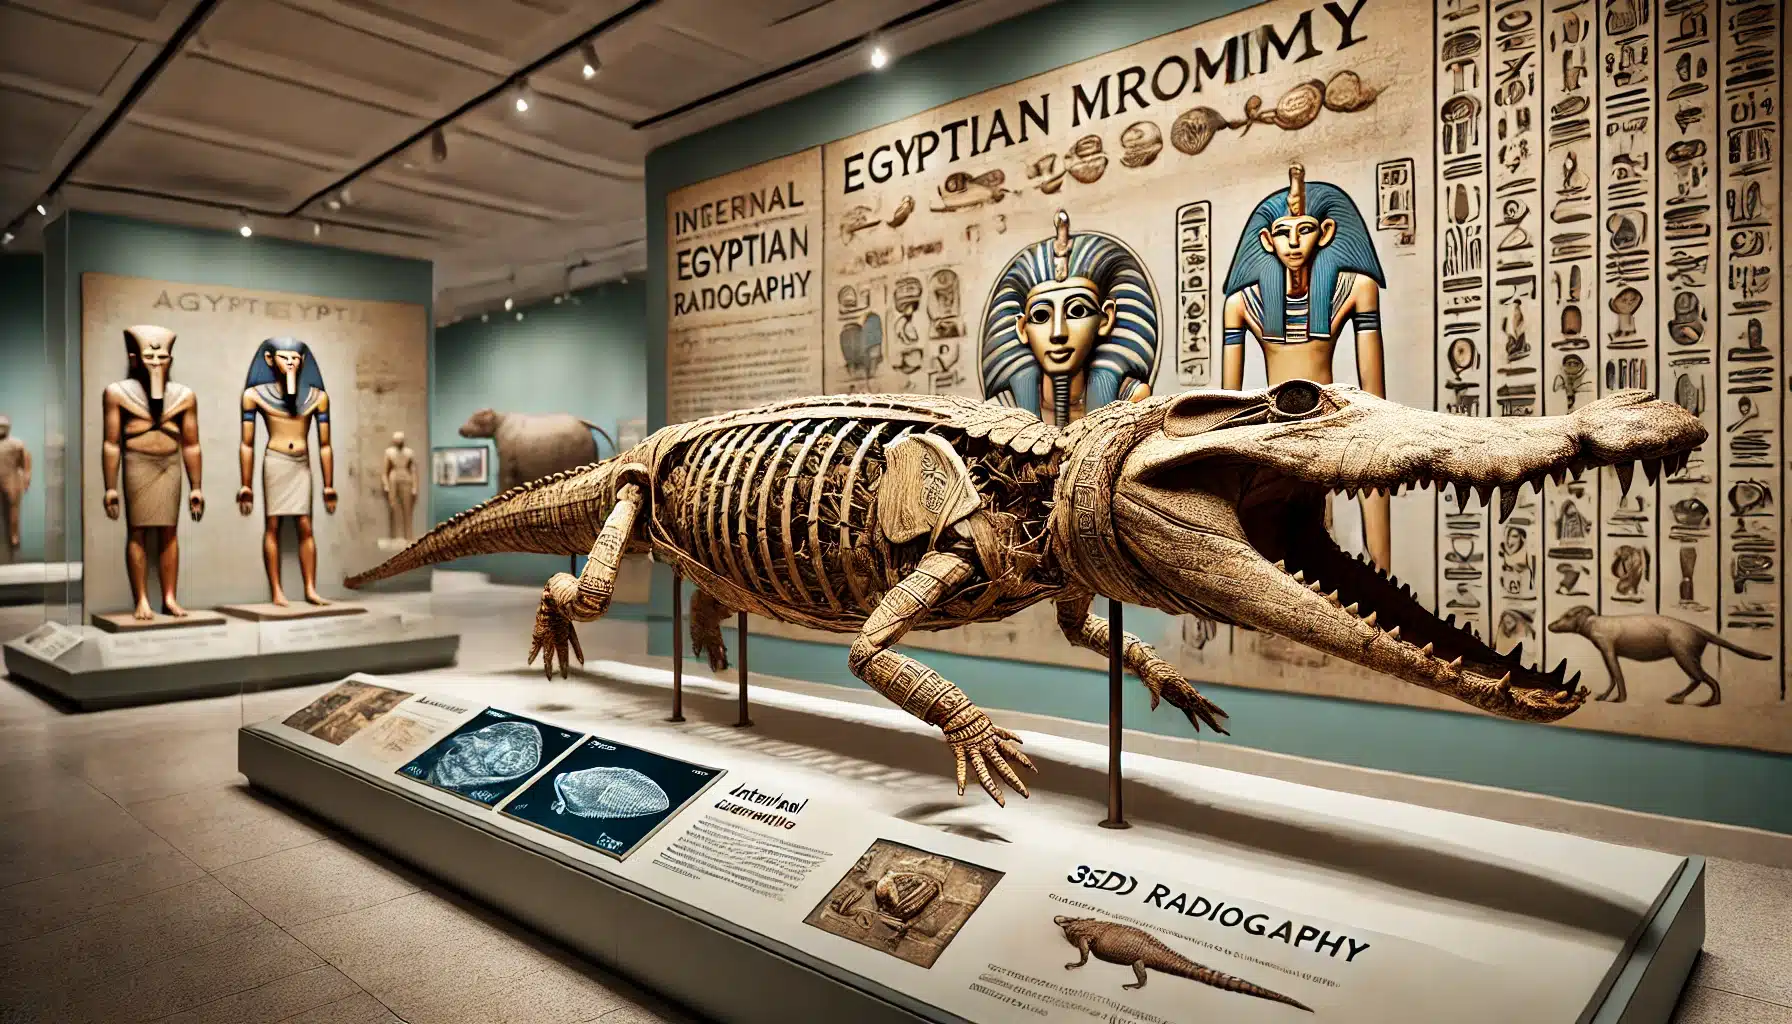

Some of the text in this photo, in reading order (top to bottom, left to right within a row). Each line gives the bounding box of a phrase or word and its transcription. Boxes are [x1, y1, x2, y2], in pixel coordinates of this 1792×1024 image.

[844, 93, 1050, 195] EGYPTIAN
[676, 224, 808, 281] EGYPTIAN
[1143, 883, 1371, 962] RADIOGAPHY
